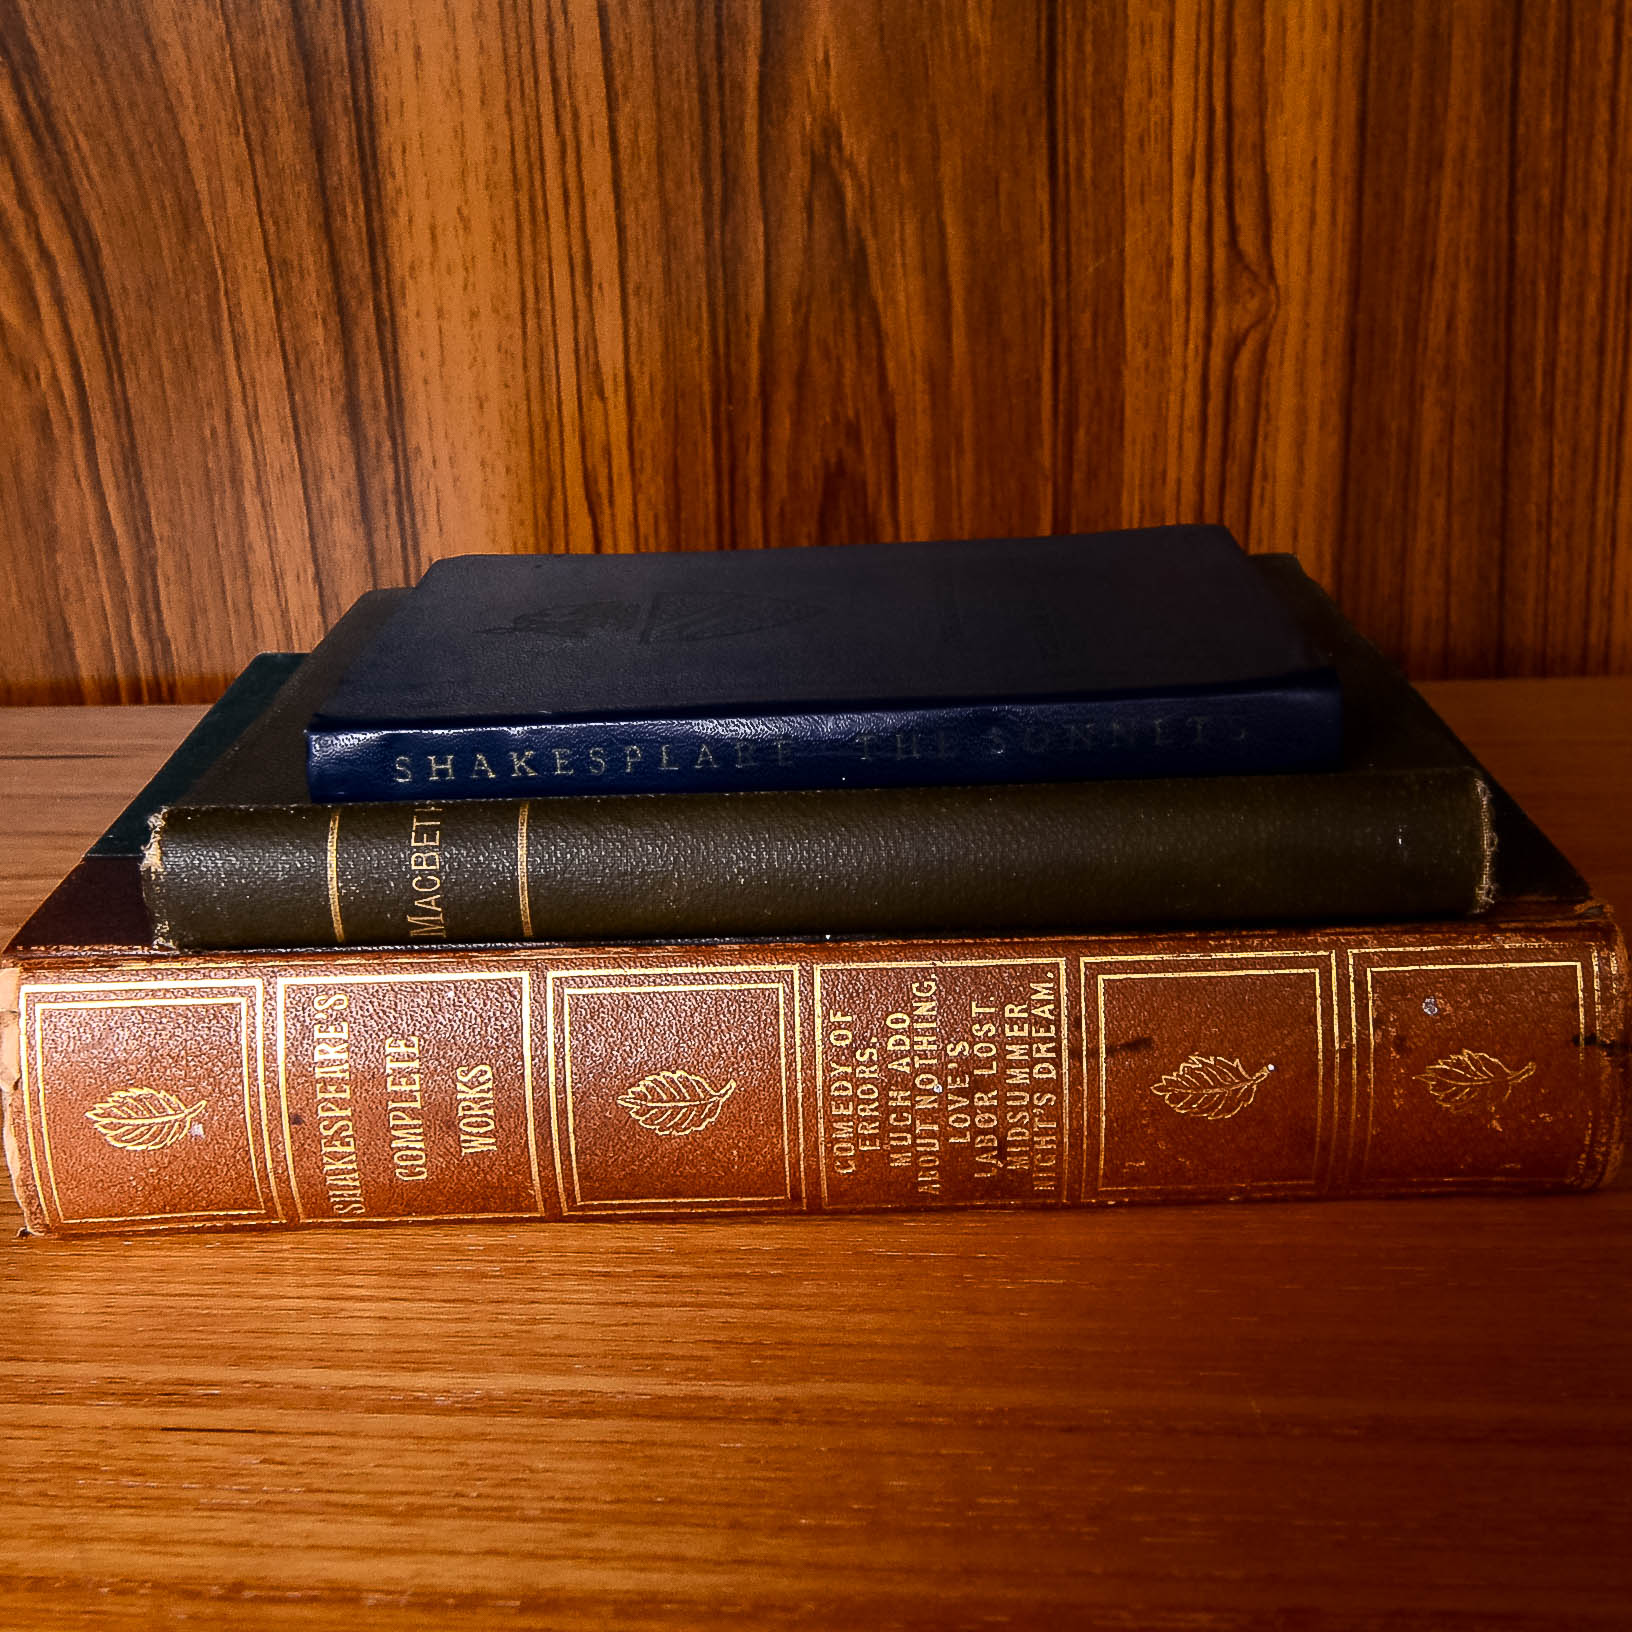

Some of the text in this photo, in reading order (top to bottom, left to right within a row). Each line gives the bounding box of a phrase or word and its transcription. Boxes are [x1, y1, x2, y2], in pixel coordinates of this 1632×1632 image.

[856, 733, 949, 762] THE
[313, 993, 366, 1214] SHAKESPEARE'S
[385, 1034, 428, 1182] COMPLETE
[456, 1063, 497, 1155] WORKS
[829, 1009, 856, 1174] COMEDY OF
[856, 1036, 881, 1151] ERRORS.
[886, 1012, 912, 1167] MUCH ADO
[946, 1039, 971, 1143] LOVE'S
[971, 996, 998, 1178] LABOR LOST.
[1004, 1002, 1030, 1170] MIDSUMMER
[1030, 970, 1057, 1190] NIGHT'S DREAM.
[915, 1120, 941, 1195] ABOUT
